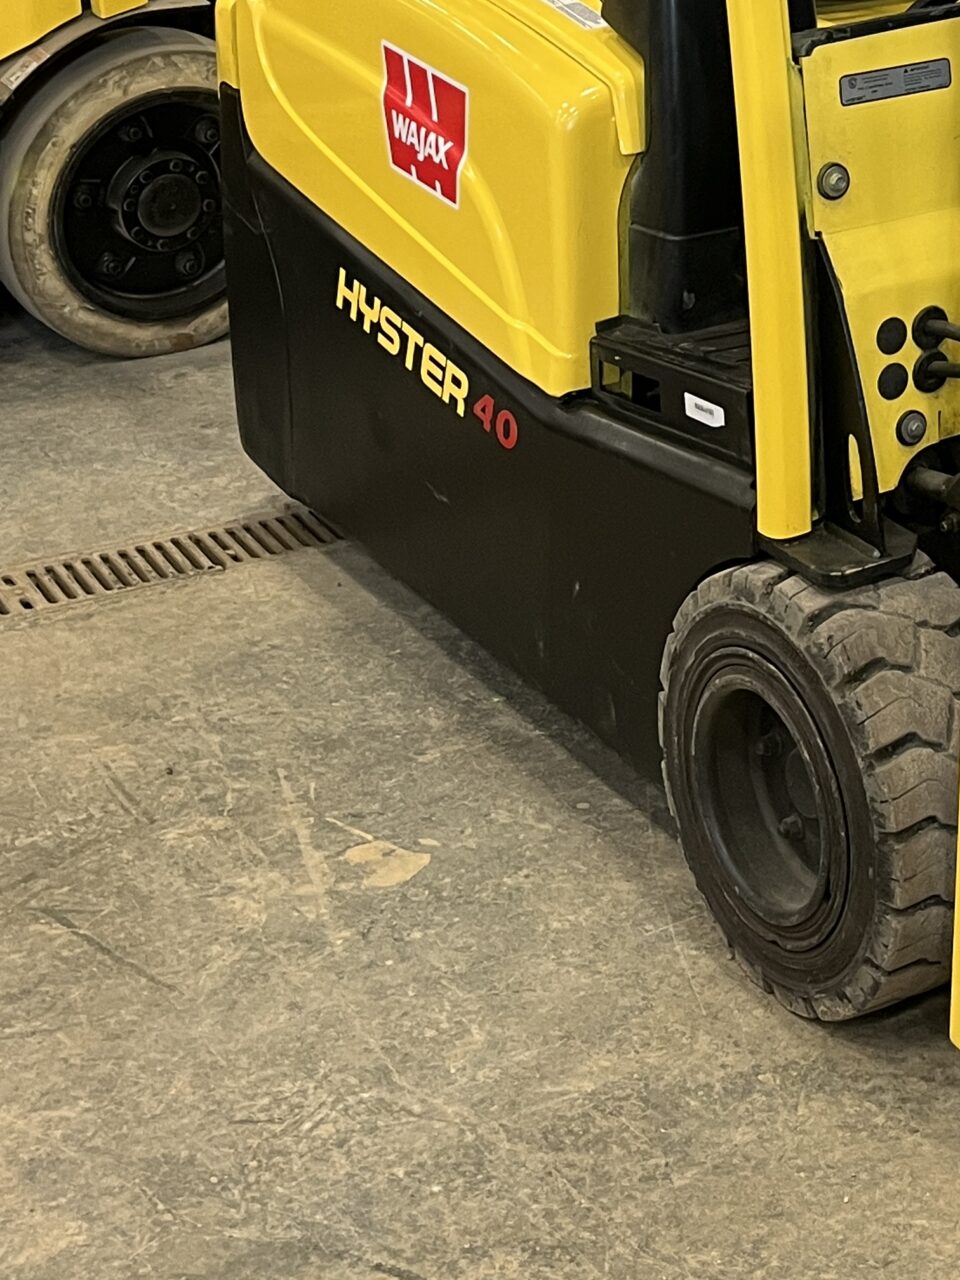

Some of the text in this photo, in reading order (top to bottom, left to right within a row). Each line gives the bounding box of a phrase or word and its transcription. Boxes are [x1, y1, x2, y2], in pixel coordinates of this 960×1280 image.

[391, 108, 454, 171] WAJAX
[336, 266, 518, 449] HYSTER 40
